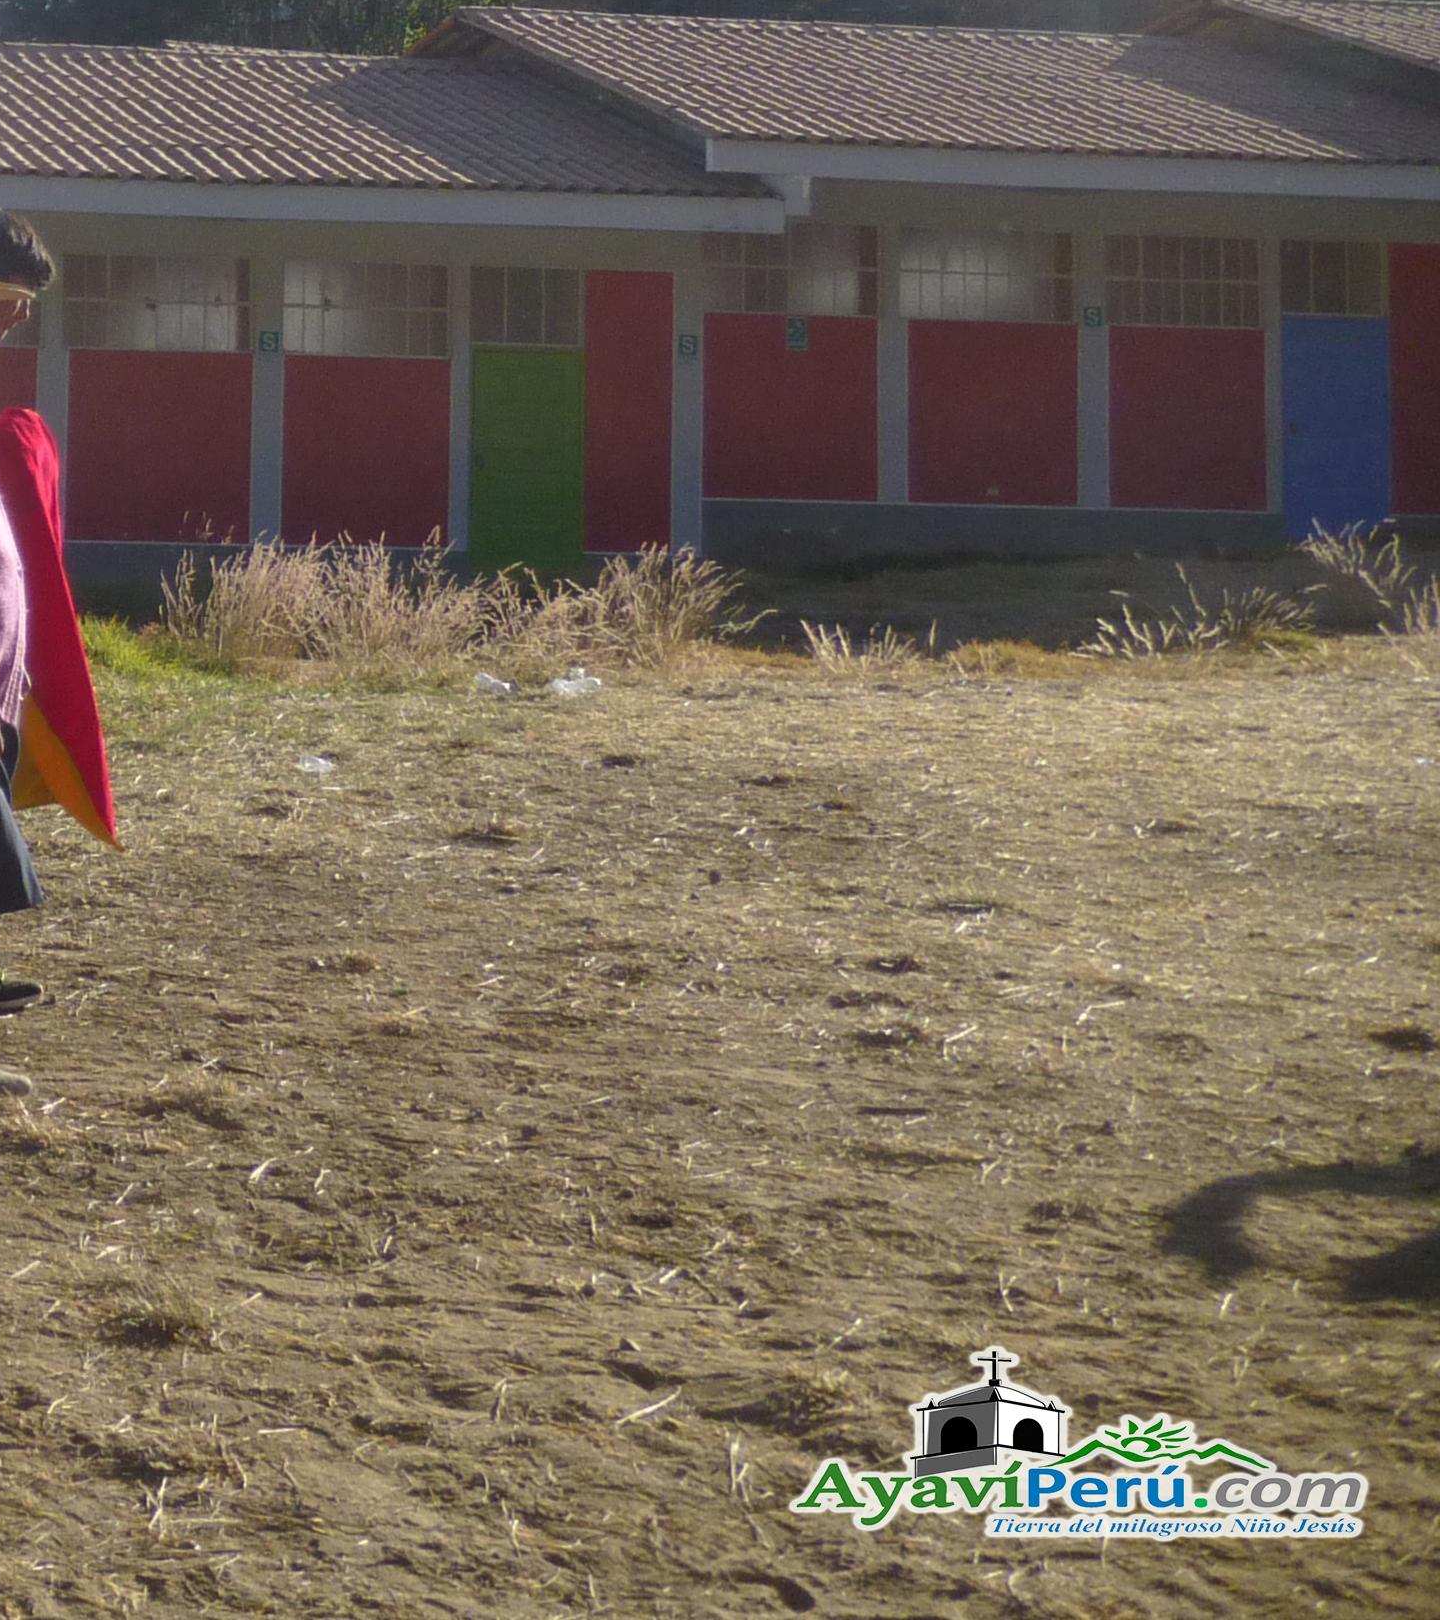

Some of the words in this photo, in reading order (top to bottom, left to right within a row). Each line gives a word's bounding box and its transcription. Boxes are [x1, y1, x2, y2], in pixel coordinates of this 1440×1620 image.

[1087, 307, 1100, 326] S
[262, 331, 276, 350] S
[681, 336, 694, 353] S
